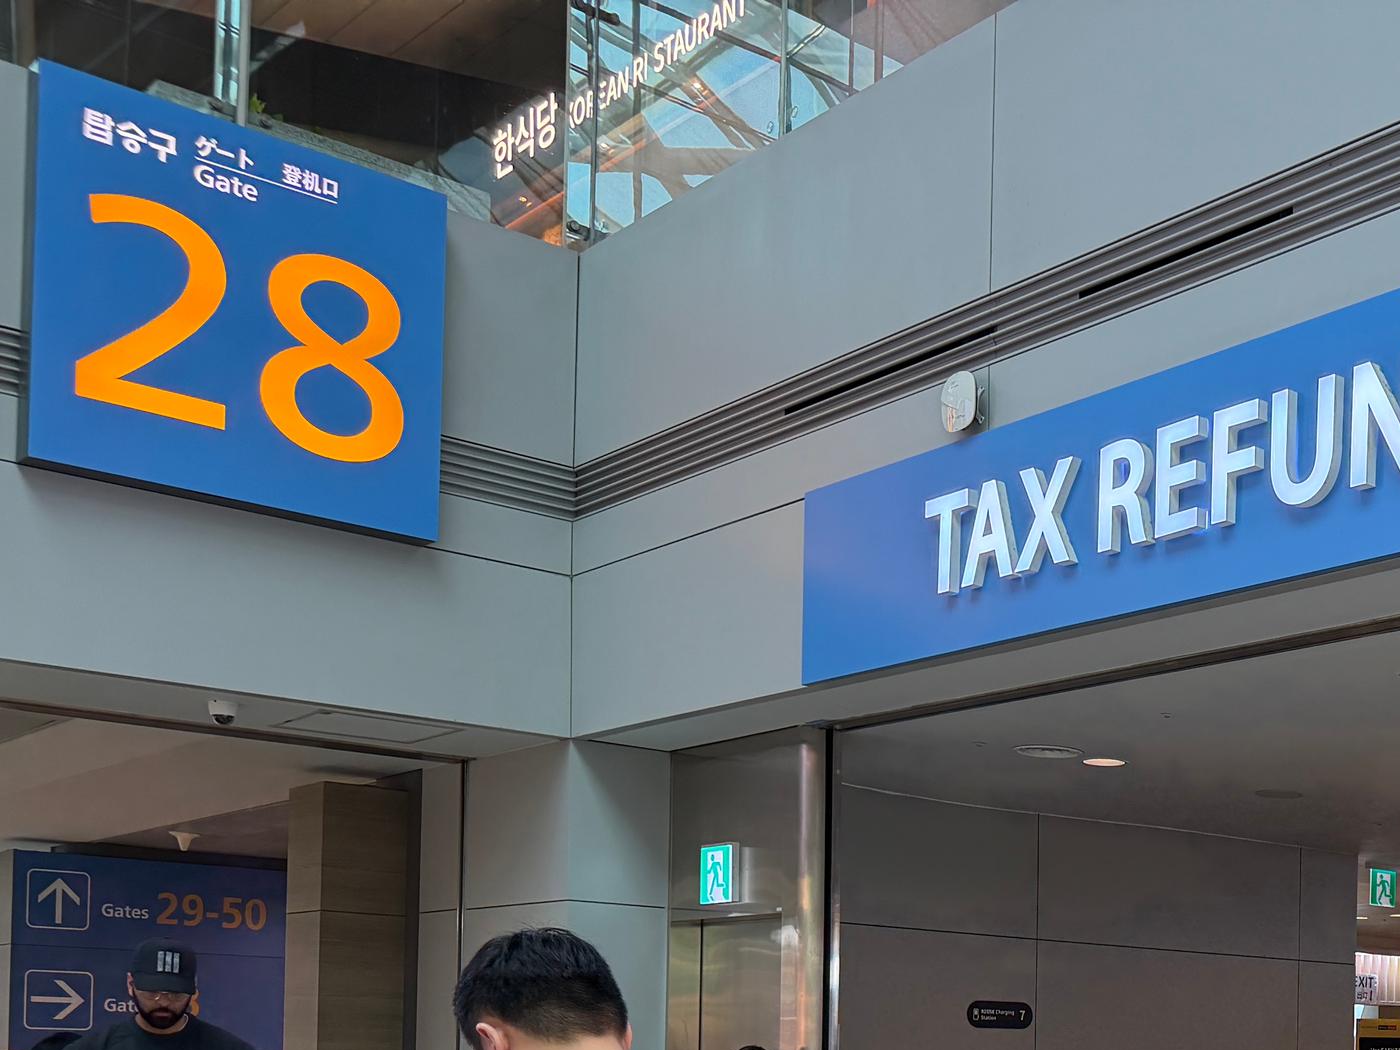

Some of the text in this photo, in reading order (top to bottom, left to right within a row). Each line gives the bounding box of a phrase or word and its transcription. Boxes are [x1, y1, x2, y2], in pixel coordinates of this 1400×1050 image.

[82, 106, 177, 163] 탑승구
[194, 135, 254, 170] ゲート
[491, 91, 559, 180] 한식당
[193, 164, 258, 202] Gate
[281, 162, 339, 199] 登机口
[75, 193, 404, 463] 28
[924, 455, 1081, 596] TAX
[101, 892, 267, 931] Gates 29-50
[103, 998, 139, 1014] Gat
[1019, 1009, 1026, 1021] 7
